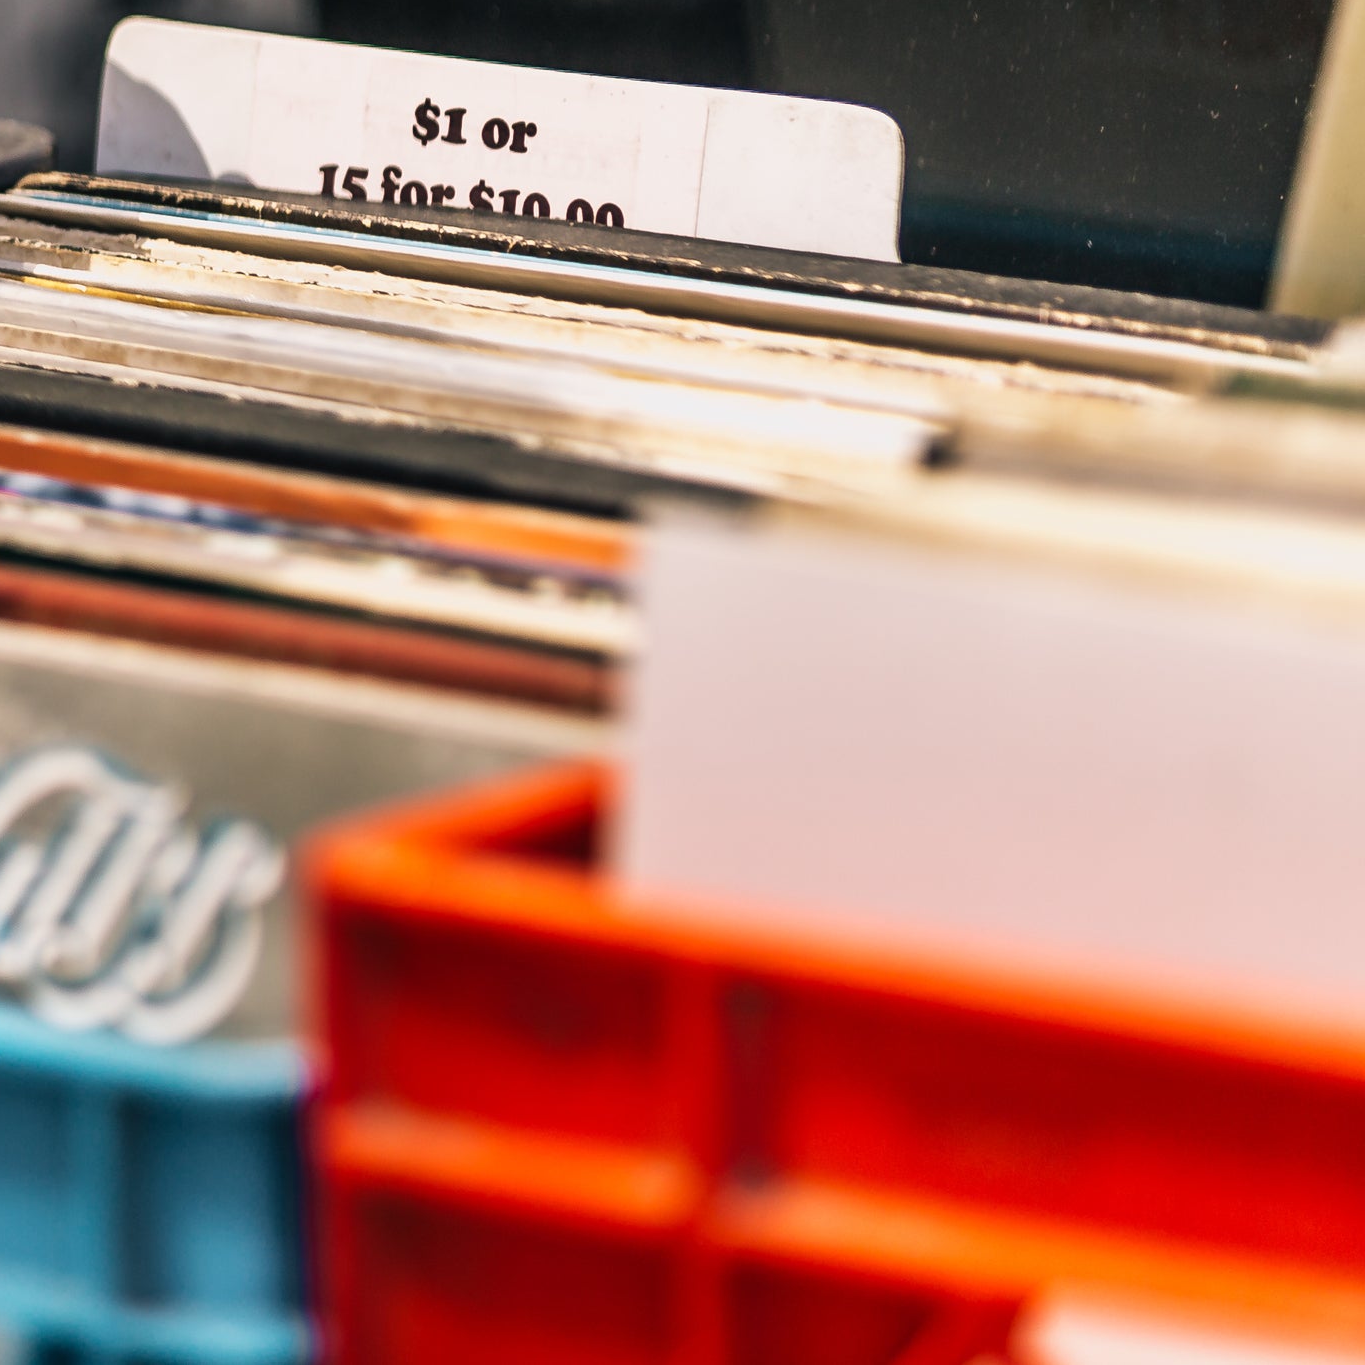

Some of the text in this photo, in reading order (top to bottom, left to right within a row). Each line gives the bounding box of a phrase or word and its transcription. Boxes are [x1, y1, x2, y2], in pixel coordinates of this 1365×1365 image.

[412, 97, 537, 153] $1 or
[319, 163, 625, 229] 15 for $1000
